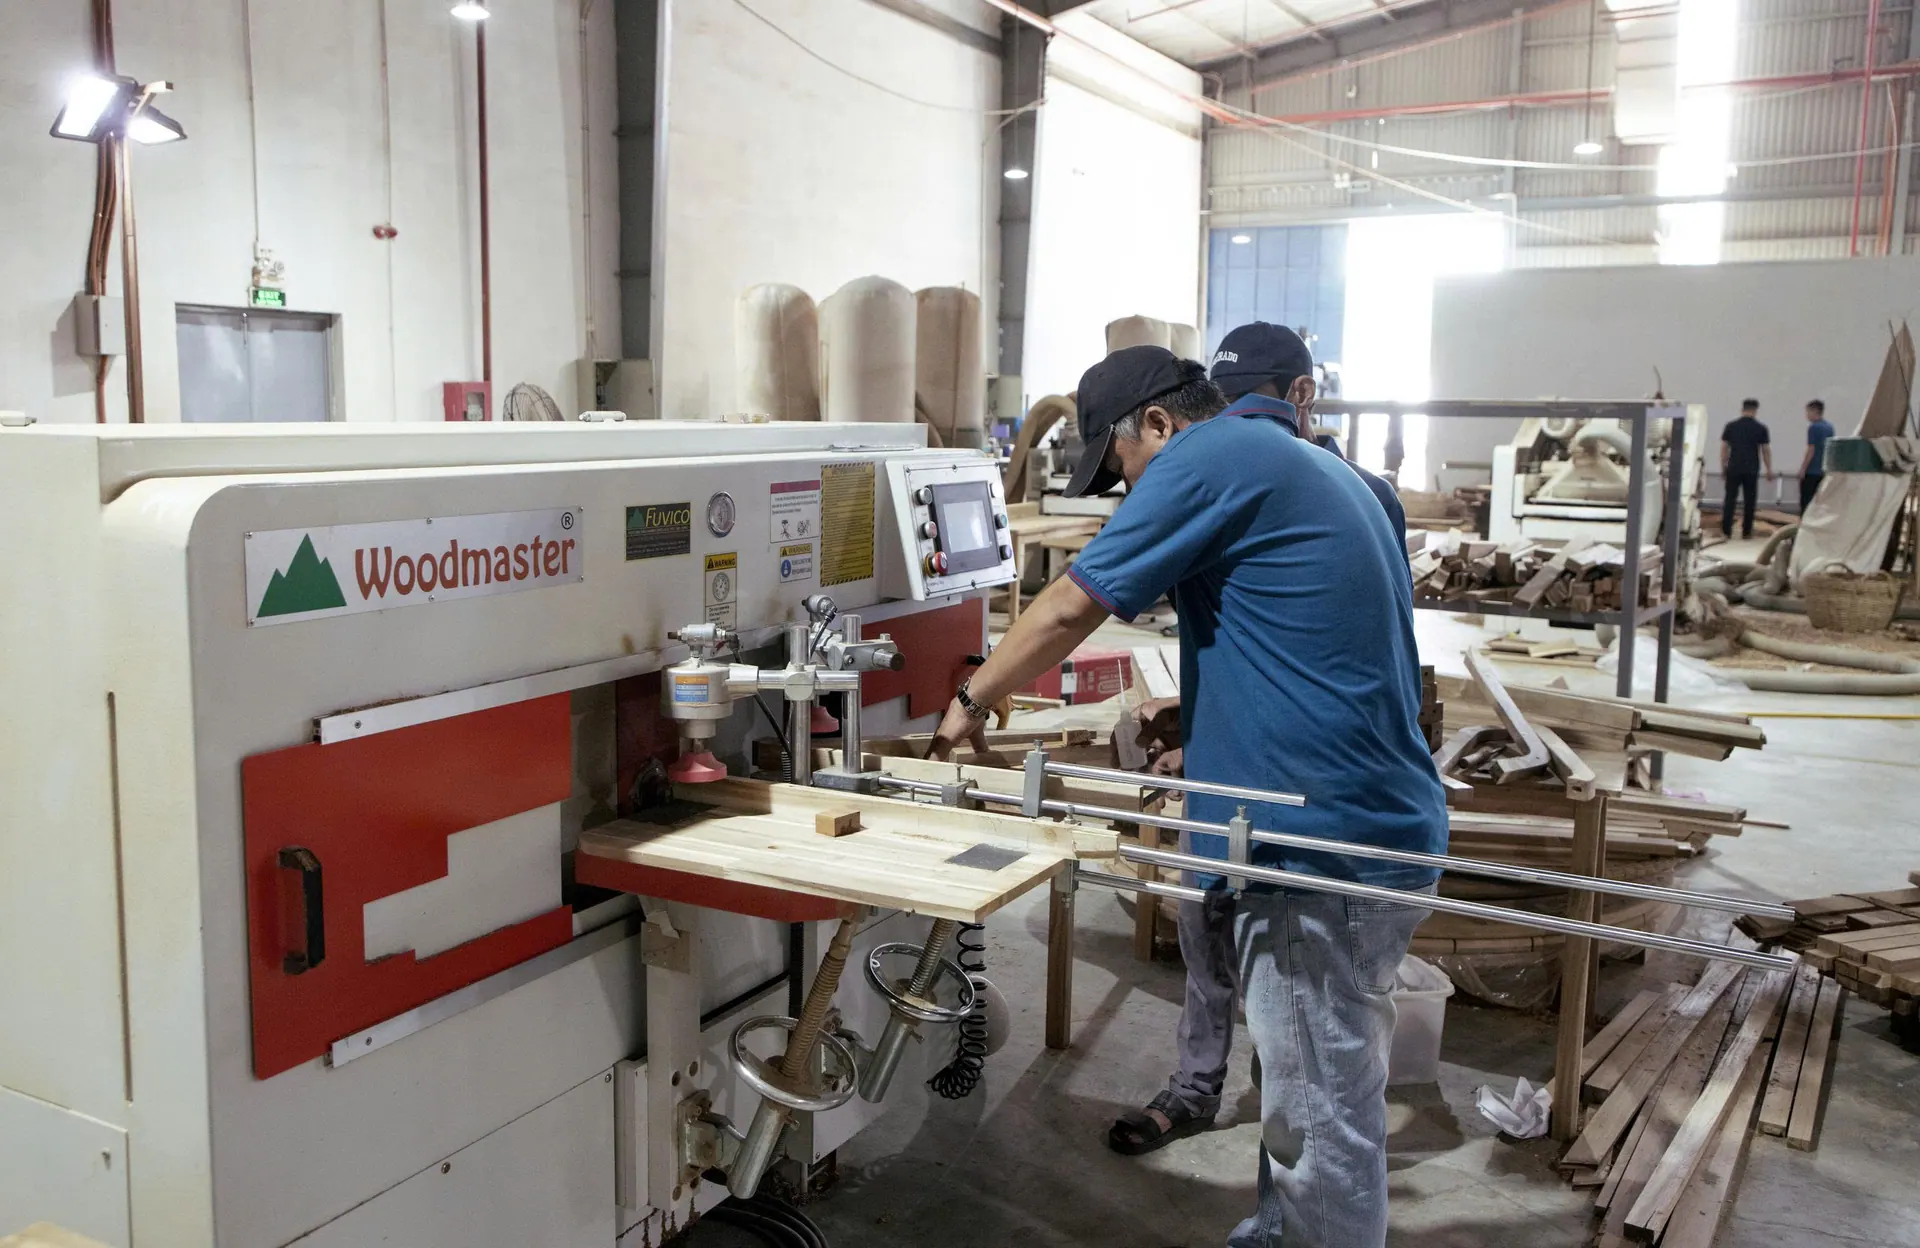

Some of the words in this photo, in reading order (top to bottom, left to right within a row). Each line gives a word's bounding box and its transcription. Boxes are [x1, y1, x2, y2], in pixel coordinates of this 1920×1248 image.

[645, 507, 690, 528] FUVICO
[788, 545, 811, 554] WARNING
[355, 535, 575, 600] Woodmaster
[714, 558, 736, 568] WARNING
